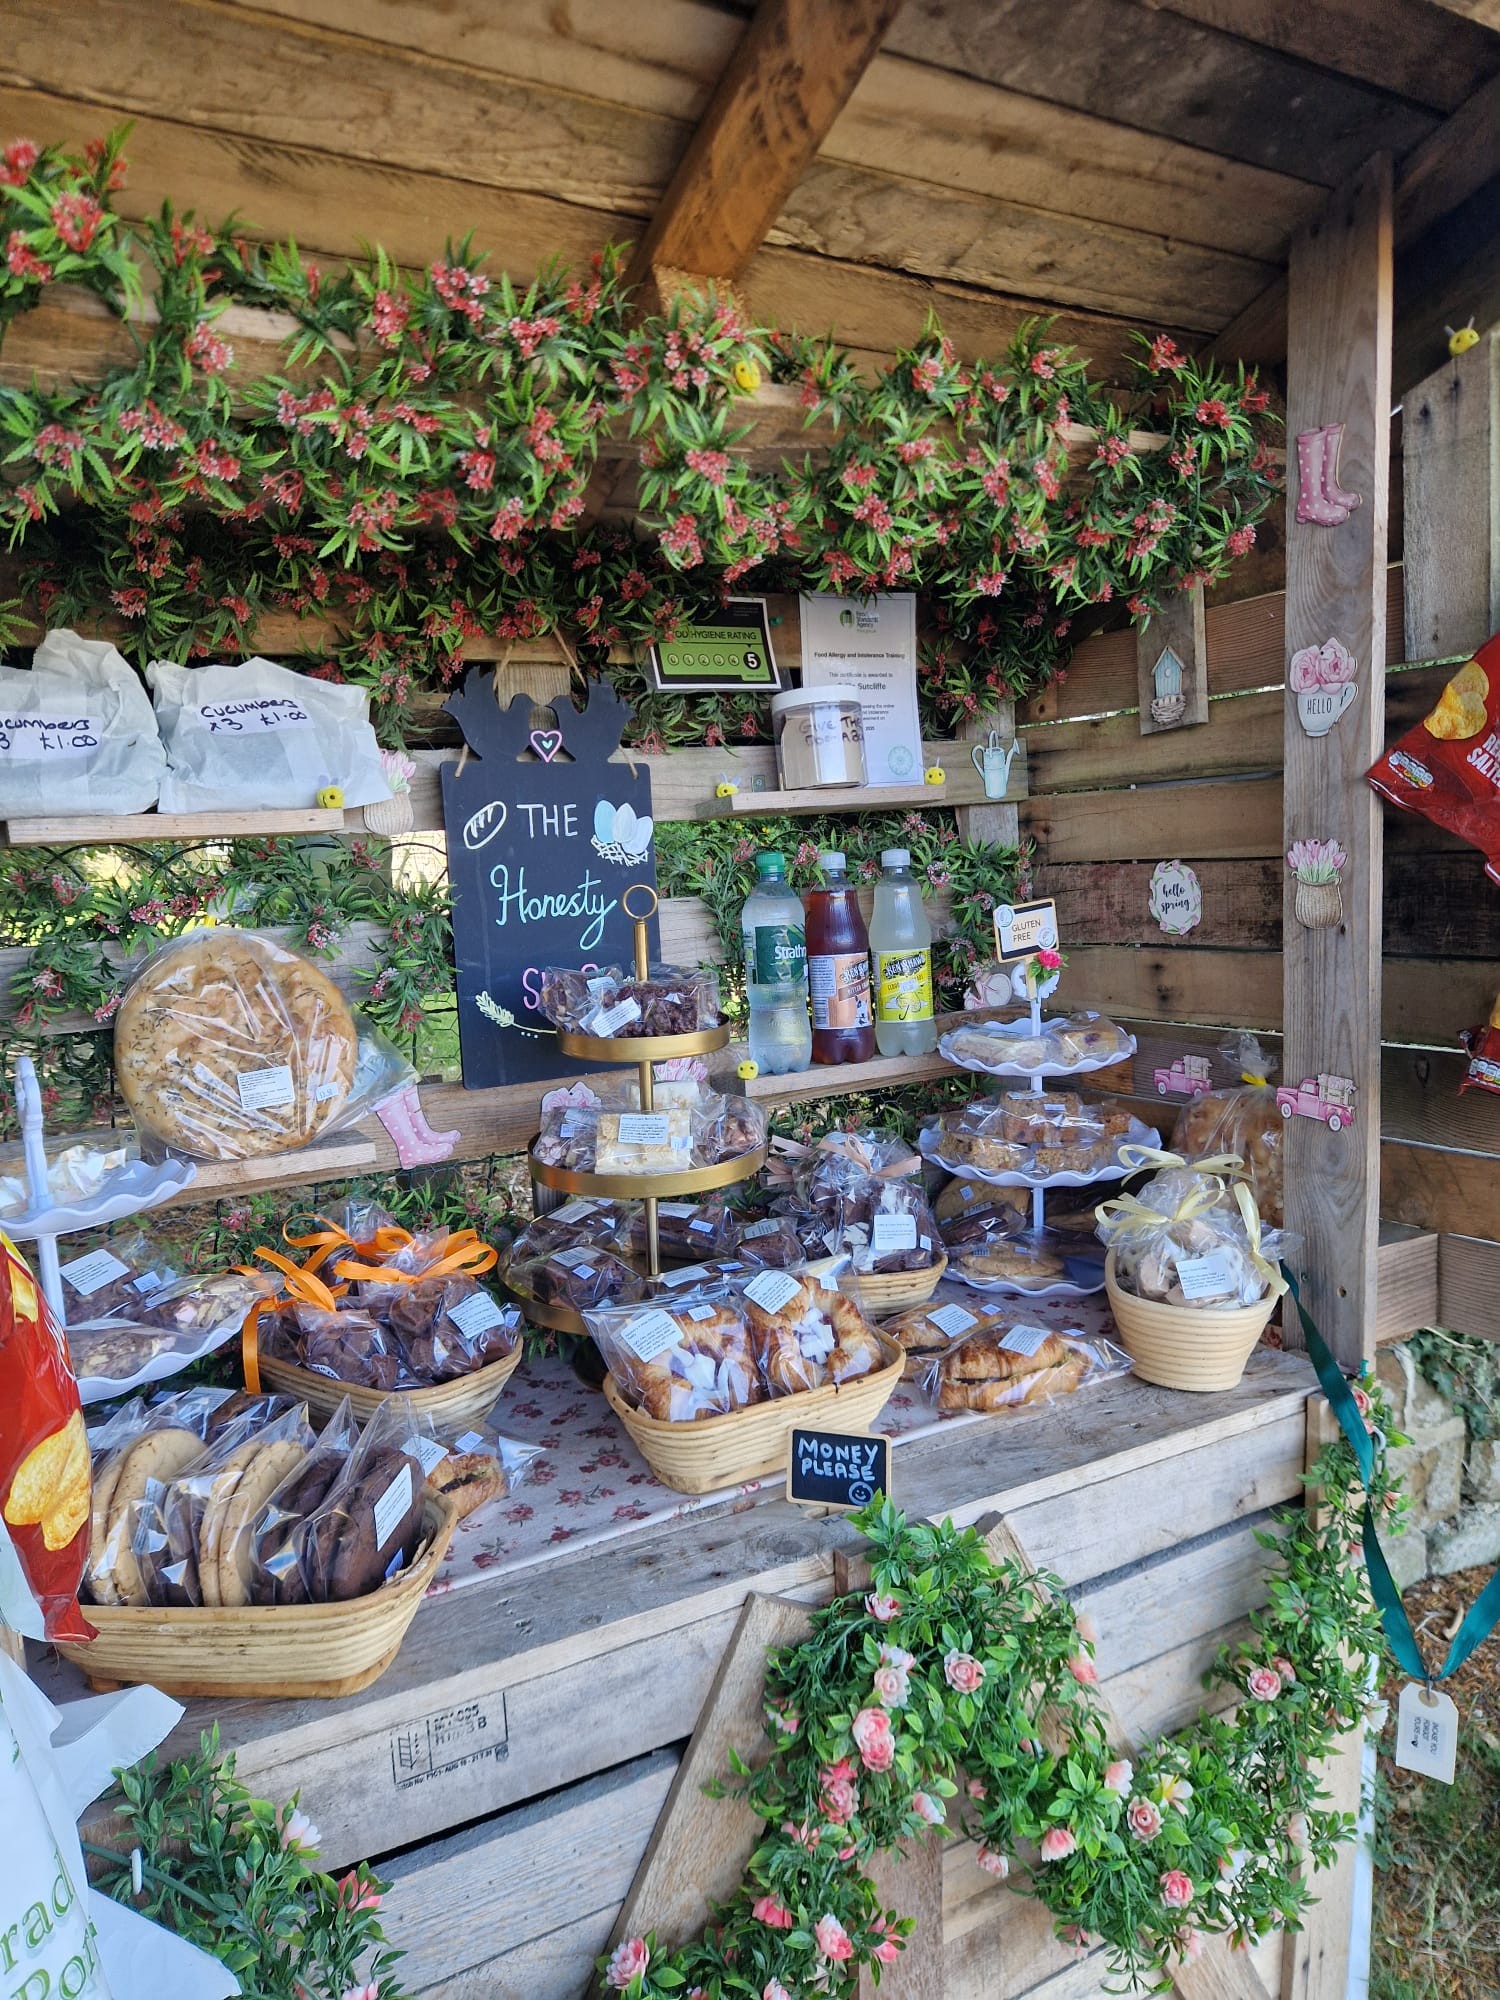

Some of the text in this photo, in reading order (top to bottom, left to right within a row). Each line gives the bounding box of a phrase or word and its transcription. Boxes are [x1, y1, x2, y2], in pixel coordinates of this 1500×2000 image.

[692, 630, 726, 639] HYGIENE
[727, 631, 757, 640] RATING
[747, 653, 758, 669] 5
[1307, 698, 1332, 715] HELLO
[40, 732, 98, 750] £1.00
[517, 804, 578, 838] THE
[1162, 882, 1185, 897] hello
[490, 864, 617, 950] Honesty
[1161, 899, 1190, 915] spring
[1012, 920, 1041, 931] GLUTEN
[1013, 932, 1032, 942] FREE
[798, 1437, 878, 1466] MONEY
[801, 1457, 876, 1481] PLEASE
